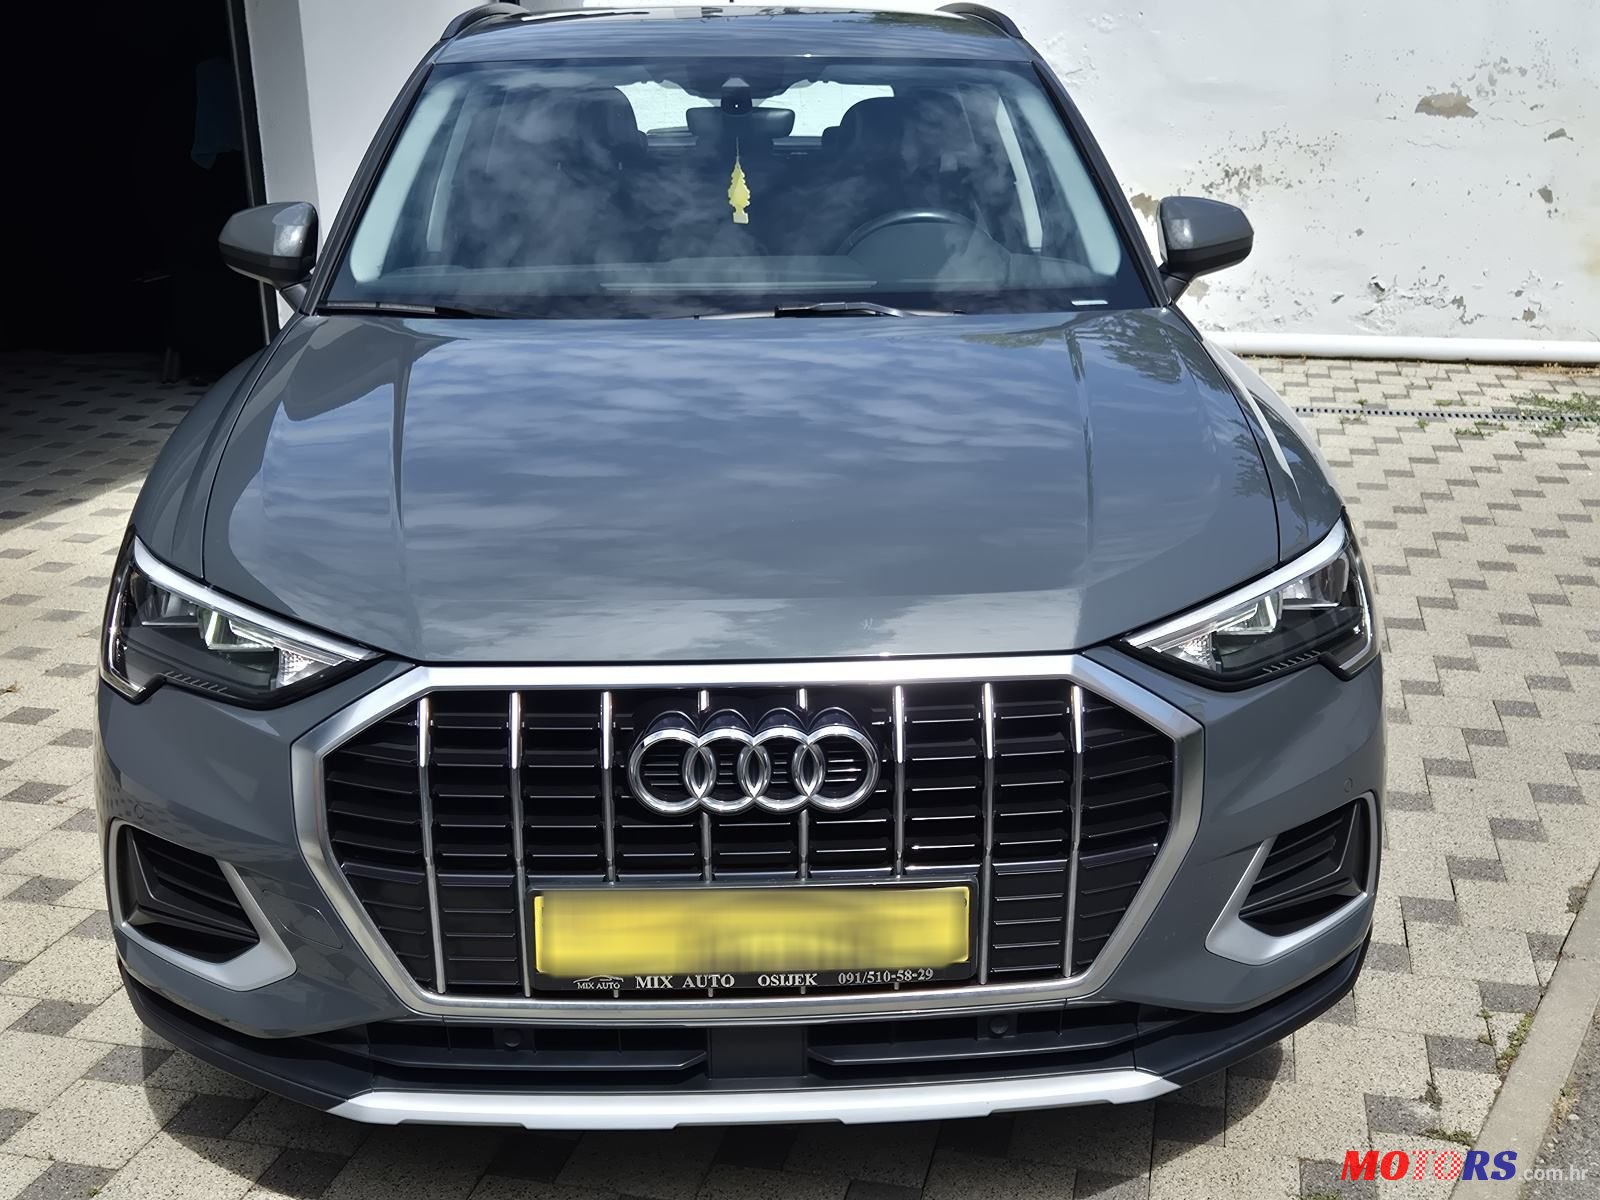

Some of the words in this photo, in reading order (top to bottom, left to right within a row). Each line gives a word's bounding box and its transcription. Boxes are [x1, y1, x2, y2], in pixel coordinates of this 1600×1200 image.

[635, 975, 673, 989] MIX
[682, 974, 735, 988] AUTO
[757, 973, 818, 987] OSIJEK
[838, 968, 934, 985] 091/510-58-29
[577, 982, 595, 990] MIX
[596, 982, 621, 990] AUTO
